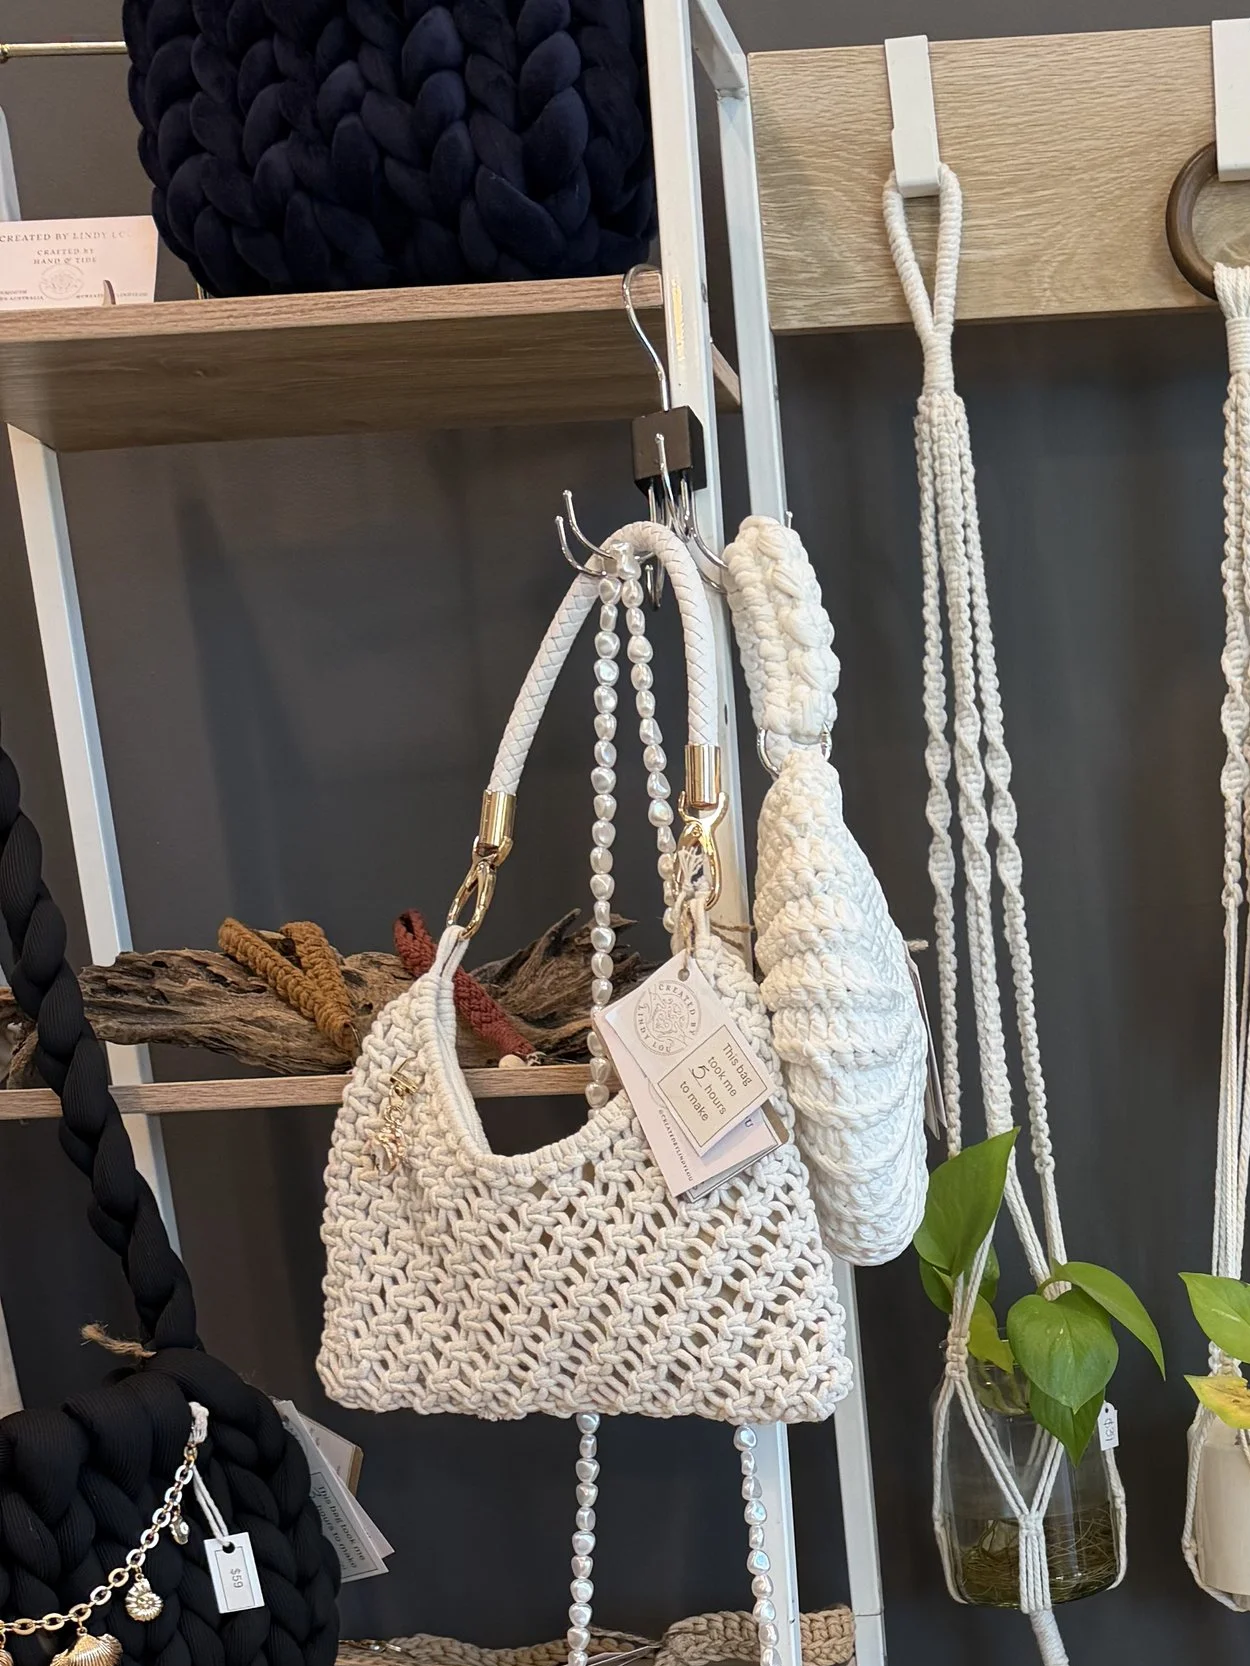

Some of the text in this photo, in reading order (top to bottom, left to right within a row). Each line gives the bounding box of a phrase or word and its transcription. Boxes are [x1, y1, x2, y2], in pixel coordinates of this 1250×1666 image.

[55, 233, 69, 241] BY
[658, 984, 696, 1016] CREATED
[652, 1041, 672, 1053] LOU
[722, 1042, 753, 1087] This bag
[691, 1065, 727, 1115] 5 hours
[707, 1056, 737, 1097] took me
[679, 1080, 709, 1122] to make
[318, 1486, 332, 1505] This
[340, 1524, 355, 1545] took
[353, 1546, 365, 1561] me
[332, 1532, 341, 1542] to
[339, 1543, 357, 1568] make
[230, 1568, 244, 1589] $59
